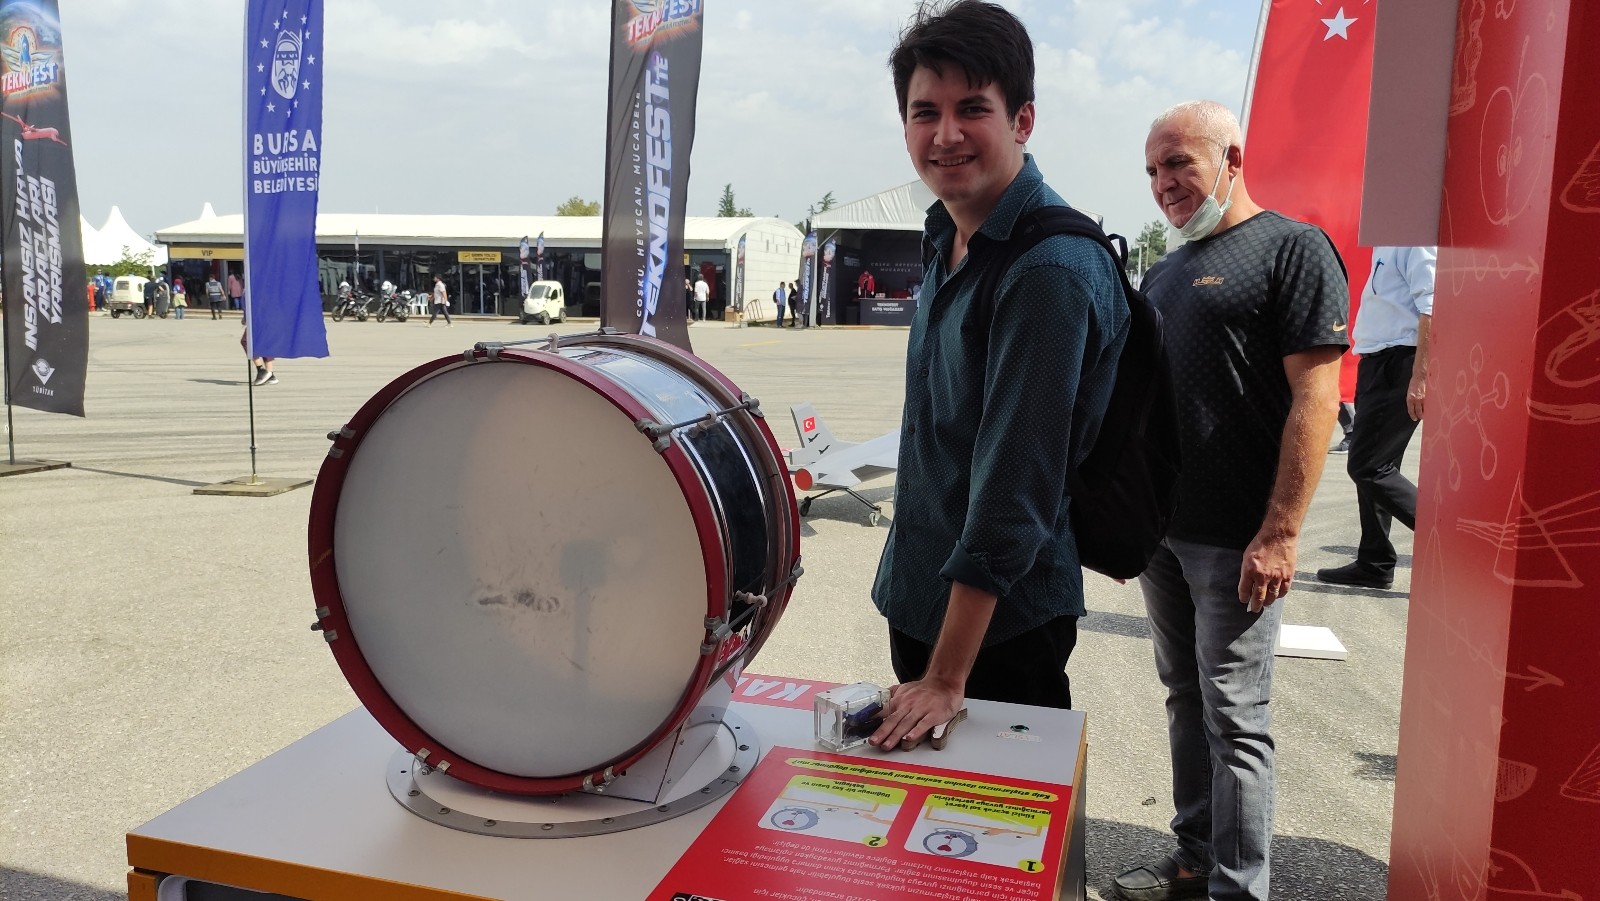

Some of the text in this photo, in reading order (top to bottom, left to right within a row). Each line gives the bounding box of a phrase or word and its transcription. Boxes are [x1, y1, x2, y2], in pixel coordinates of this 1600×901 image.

[628, 0, 700, 43] TEKNFES
[1, 62, 58, 94] TEKNOFEST
[254, 130, 318, 155] BURSA
[14, 138, 30, 221] HAVA
[635, 182, 644, 256] HEYECAN,
[895, 772, 915, 780] nasıl
[916, 776, 942, 784] sesine
[944, 780, 976, 791] davulun
[1031, 792, 1050, 800] Kalp
[868, 836, 881, 846] 2
[812, 846, 832, 854] ritmi
[834, 850, 865, 859] davulun
[794, 852, 842, 864] yuvadayken
[866, 855, 898, 865] Böylece
[750, 861, 788, 873] gelmesini
[1026, 860, 1036, 872] 1
[789, 867, 806, 876] hale
[847, 869, 906, 884] koyduğunuzda
[934, 866, 978, 878] atışlarımız
[807, 871, 851, 883] duyulabilir
[980, 874, 998, 882] kalp
[852, 879, 874, 887] sesle
[876, 883, 906, 892] yüksek
[907, 879, 937, 888] yuvaya
[980, 883, 1002, 891] sesin
[1000, 877, 1041, 889] başlarsak
[939, 884, 990, 896] parmağınızı
[1016, 889, 1039, 897] ölçer
